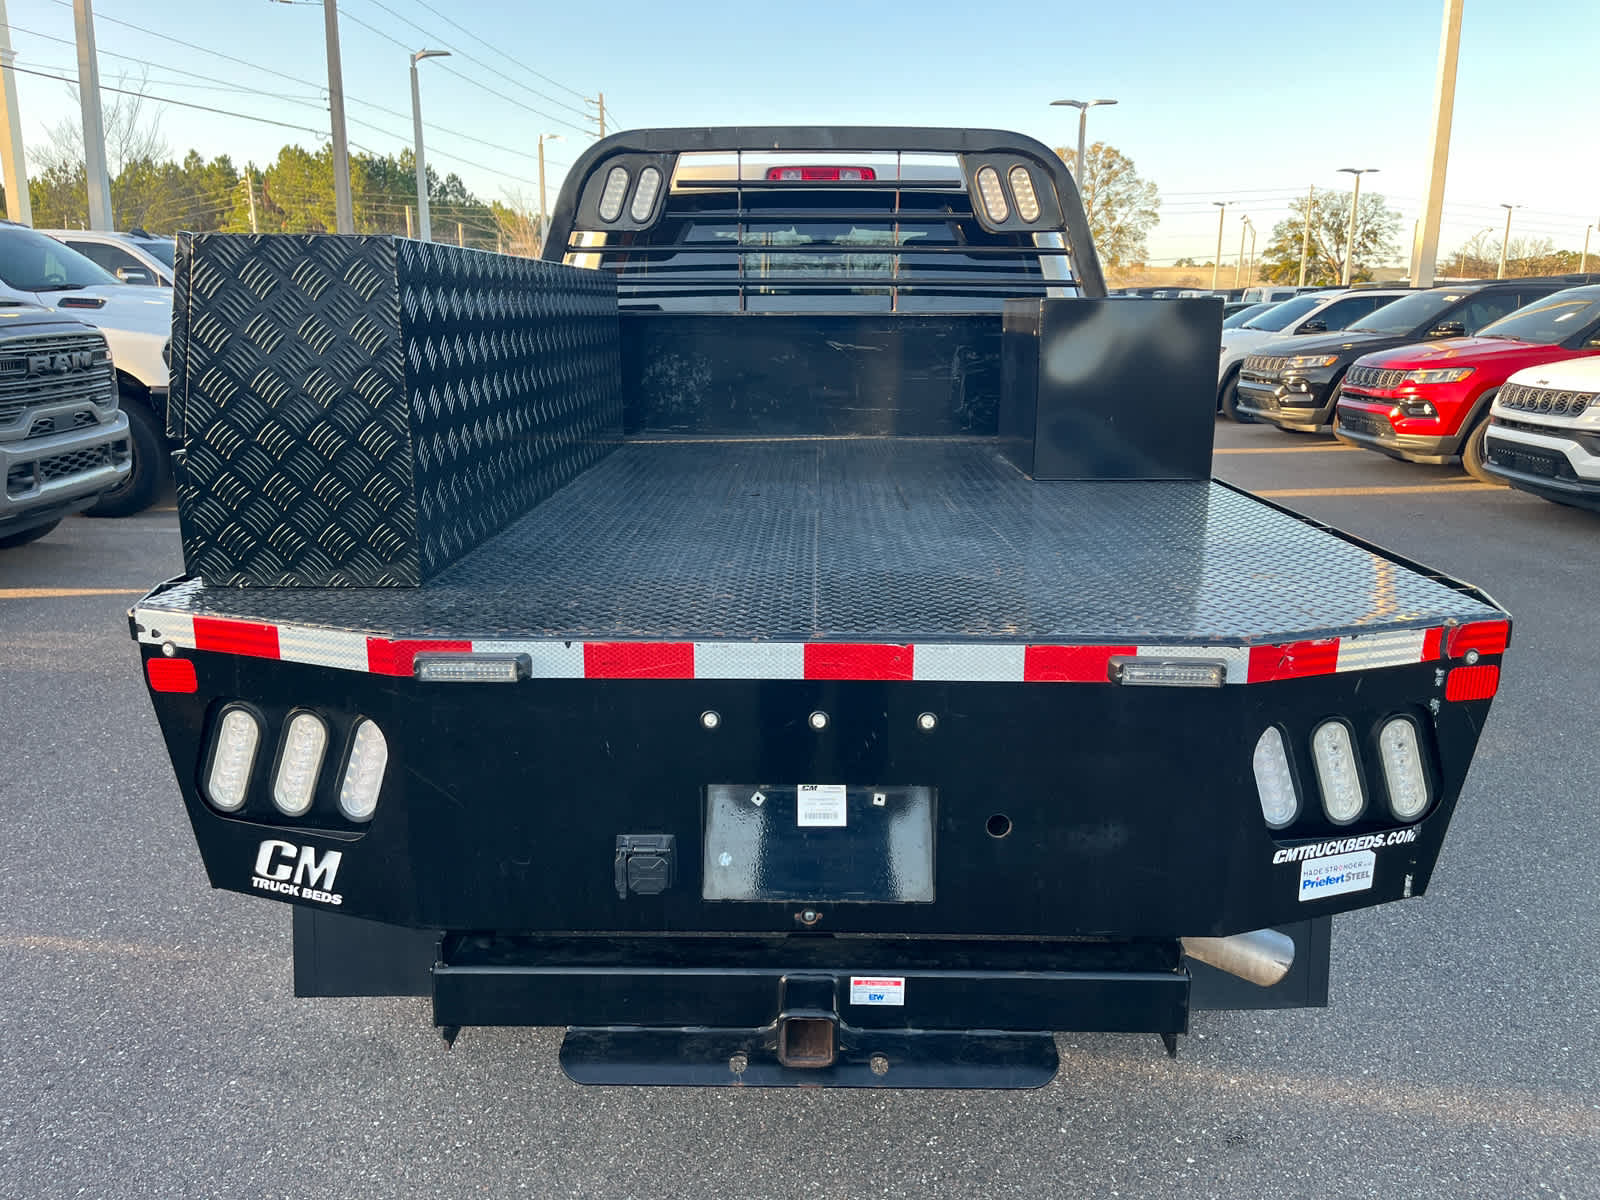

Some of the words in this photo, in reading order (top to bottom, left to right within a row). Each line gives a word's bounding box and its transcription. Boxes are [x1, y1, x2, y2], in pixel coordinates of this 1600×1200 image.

[27, 350, 92, 373] RAM
[1272, 829, 1416, 865] CMTRUCKBEDS.COM
[255, 839, 343, 891] CM
[252, 876, 300, 897] TRUCK
[301, 887, 343, 905] BEDS
[1302, 874, 1345, 890] Priefert
[1345, 870, 1370, 882] STEEL
